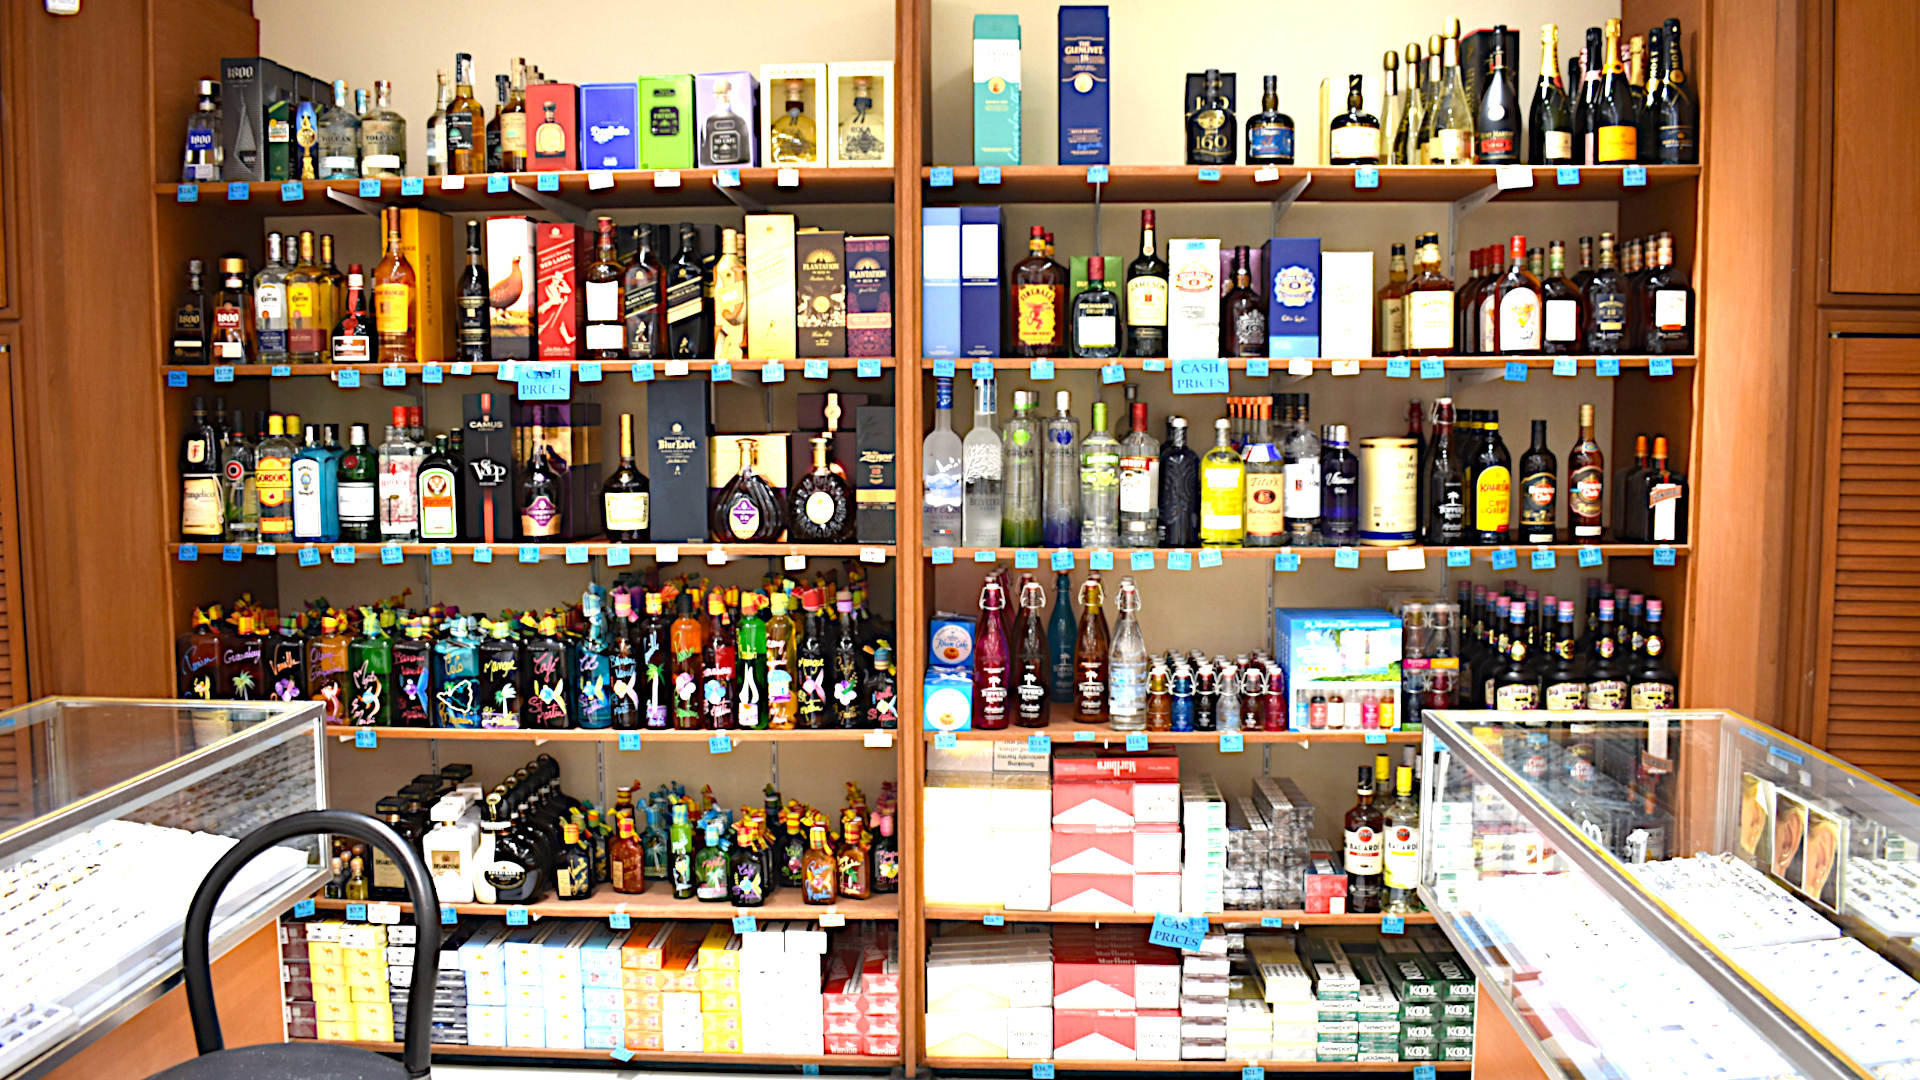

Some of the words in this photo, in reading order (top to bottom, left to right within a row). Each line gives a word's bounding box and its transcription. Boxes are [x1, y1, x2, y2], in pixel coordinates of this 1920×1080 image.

[1064, 46, 1104, 55] GLENLIVET
[226, 66, 254, 79] 1800
[190, 134, 211, 145] 1800
[1195, 135, 1228, 150] 160
[552, 253, 573, 266] LABEL
[803, 263, 840, 271] PLANTATION
[1130, 281, 1166, 292] JAMESON
[1020, 287, 1055, 302] FIREBALL
[178, 315, 200, 325] 1800
[216, 313, 239, 324] 1800
[1181, 363, 1219, 374] CASH
[526, 369, 561, 380] CASH
[1177, 379, 1226, 389] PRICES
[521, 385, 567, 395] PRICES
[469, 421, 504, 429] CAMUS
[256, 472, 289, 482] GORDON'S
[1097, 760, 1137, 777] Marlboro
[1349, 842, 1380, 851] BACARDI
[1162, 916, 1188, 931] CAS
[1153, 930, 1200, 948] PRICES
[1098, 956, 1138, 965] Marlboro
[1409, 984, 1438, 996] KOOL
[1449, 984, 1475, 996] KOOL
[1405, 1005, 1433, 1017] KOOL
[1445, 1004, 1473, 1016] KOOL
[1407, 1026, 1435, 1038] KOOL
[1447, 1025, 1474, 1037] KOOL
[830, 1044, 858, 1055] Winston
[1404, 1046, 1432, 1058] KOOL
[1445, 1046, 1473, 1058] KOOL
